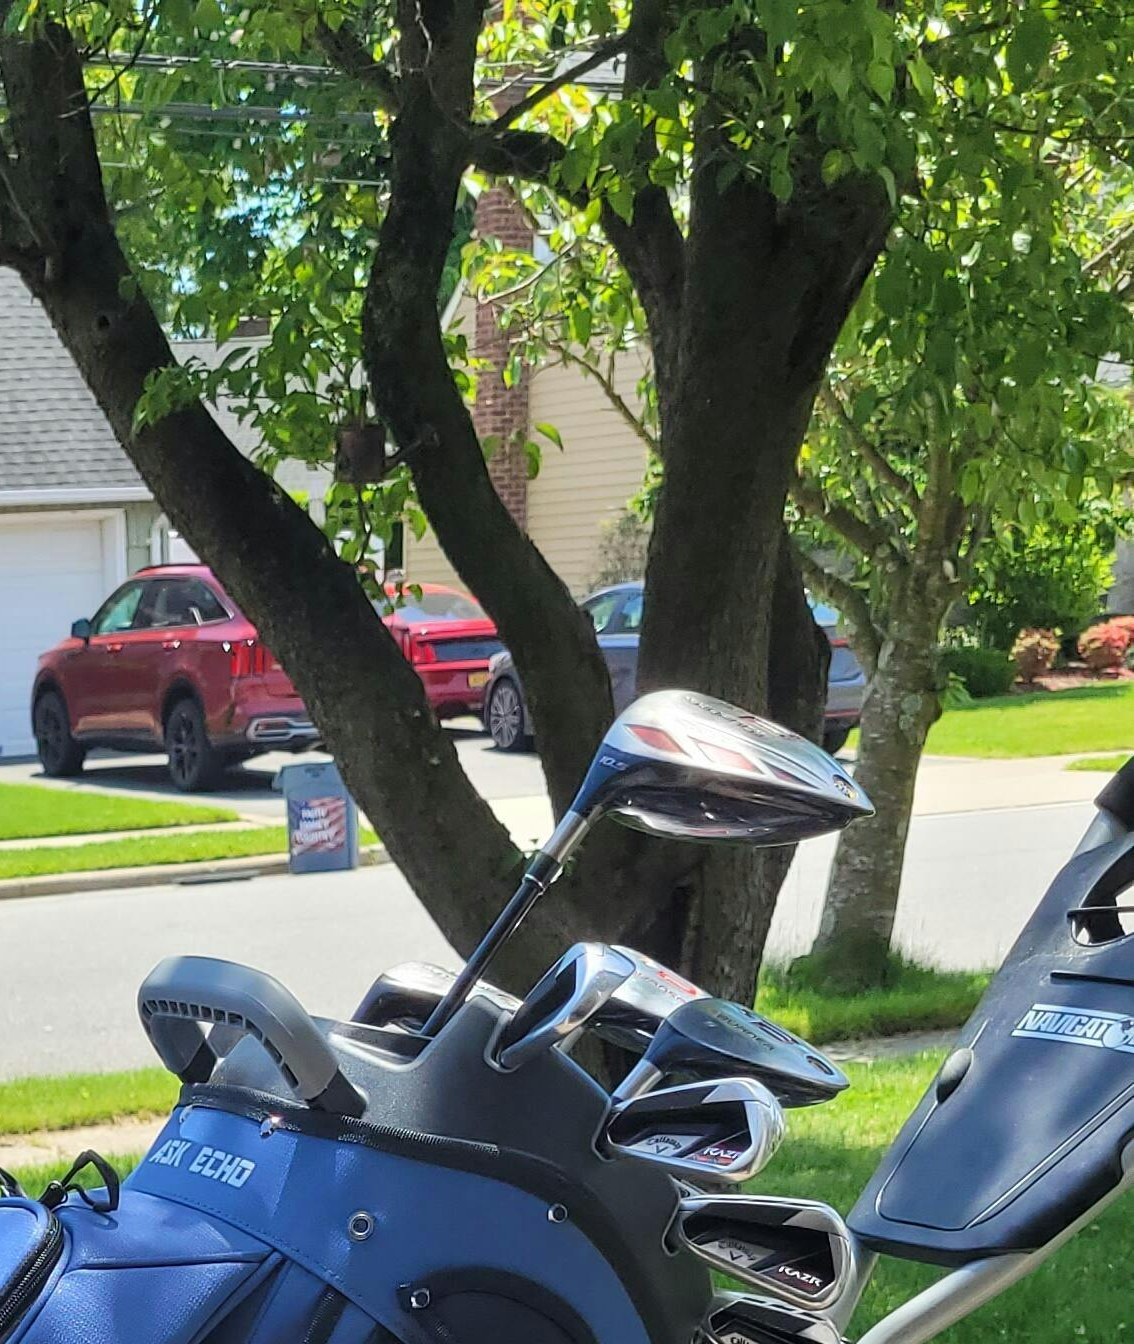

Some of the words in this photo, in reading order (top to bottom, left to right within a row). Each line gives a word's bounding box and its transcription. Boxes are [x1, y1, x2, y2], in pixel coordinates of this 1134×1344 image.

[646, 1135, 682, 1150] Callaway
[148, 1139, 193, 1168] ASK
[188, 1146, 256, 1188] ECHO
[778, 1265, 823, 1287] RAZR
